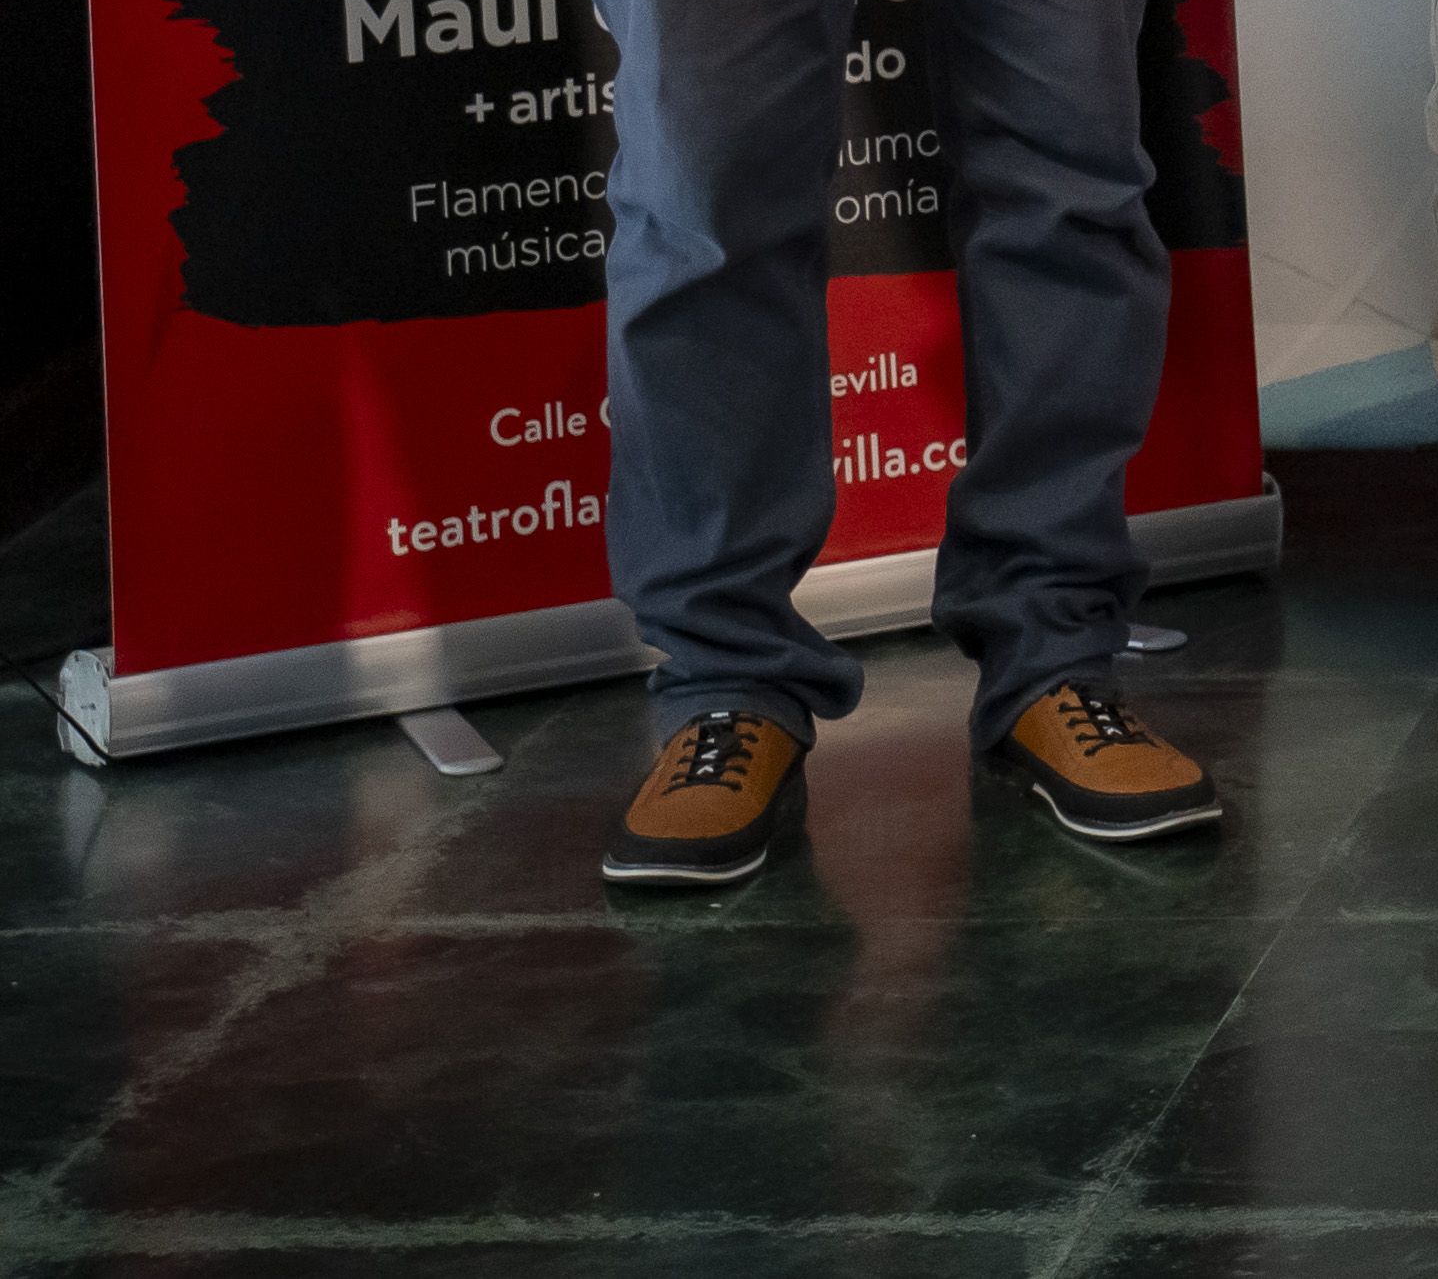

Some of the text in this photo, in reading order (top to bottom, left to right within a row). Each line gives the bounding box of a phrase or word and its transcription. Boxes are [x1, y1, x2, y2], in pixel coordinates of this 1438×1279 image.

[410, 170, 606, 223] Flamenc
[446, 226, 606, 277] música
[490, 400, 588, 447] Calle
